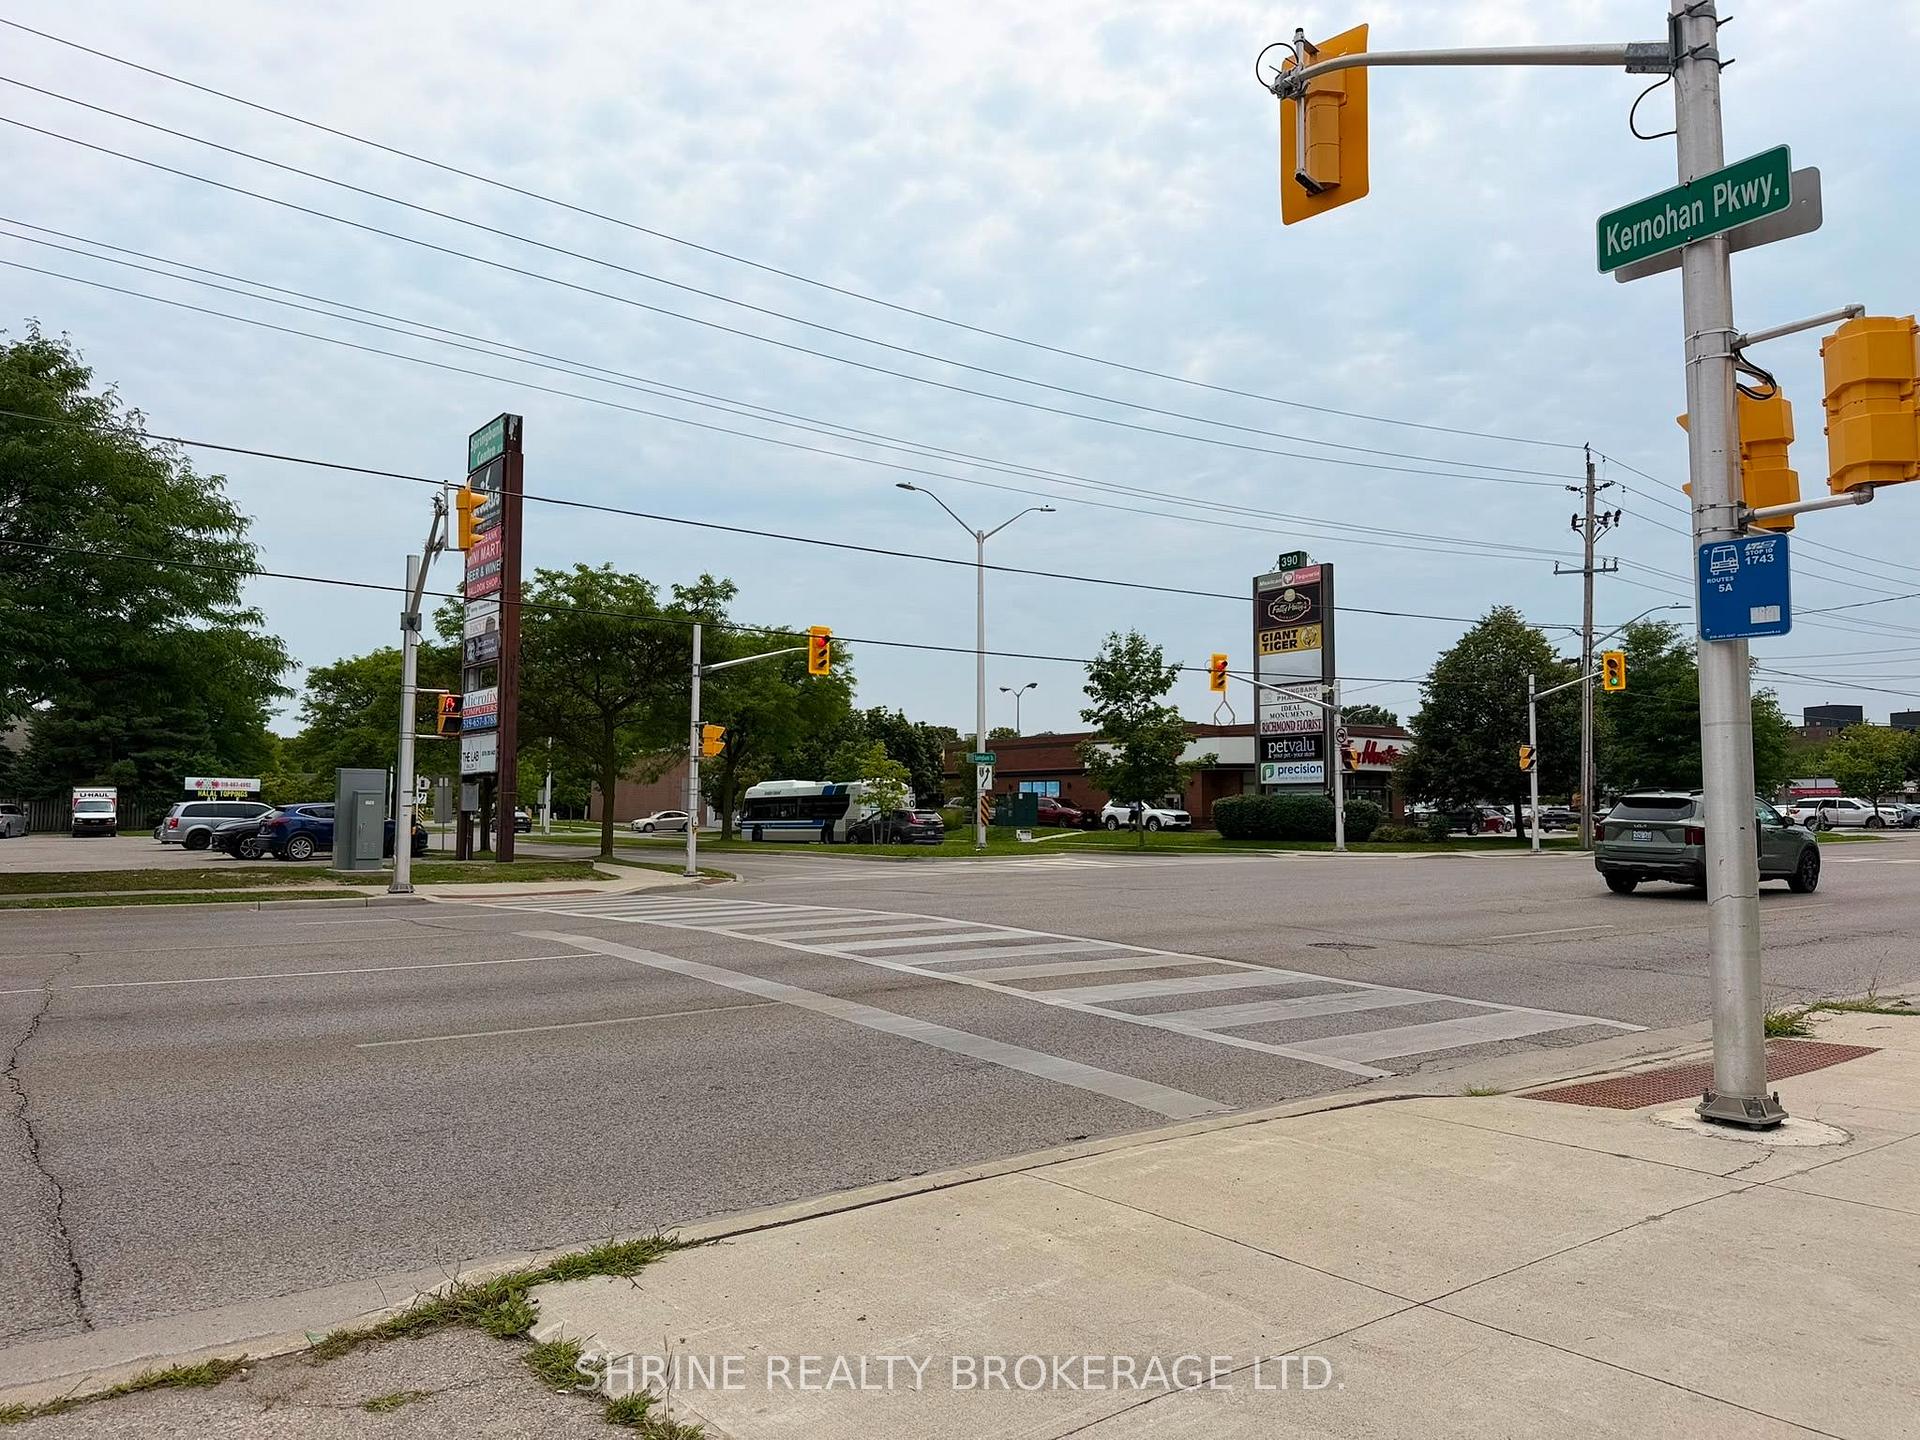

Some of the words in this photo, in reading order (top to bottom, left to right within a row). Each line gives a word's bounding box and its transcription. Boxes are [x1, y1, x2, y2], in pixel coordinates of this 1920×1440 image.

[1606, 199, 1704, 256] Kernohan
[1713, 172, 1780, 217] Pkwy.
[480, 540, 500, 561] MART
[485, 558, 500, 574] WINE
[1281, 554, 1298, 567] 390
[1745, 554, 1774, 565] 1743
[485, 576, 498, 589] SHOP
[1706, 576, 1734, 584] ROUTES
[1718, 584, 1733, 592] 5A
[1261, 629, 1298, 642] GIANT
[1262, 640, 1298, 652] TIGER
[463, 690, 497, 706] Microfix
[463, 704, 497, 717] COMPUTERS
[1269, 710, 1313, 718] MONUMENTS
[1262, 720, 1295, 732] RICHMOND
[1296, 719, 1322, 730] FLORIST
[462, 751, 471, 762] THE
[471, 750, 479, 761] LAB
[1277, 763, 1322, 776] precision
